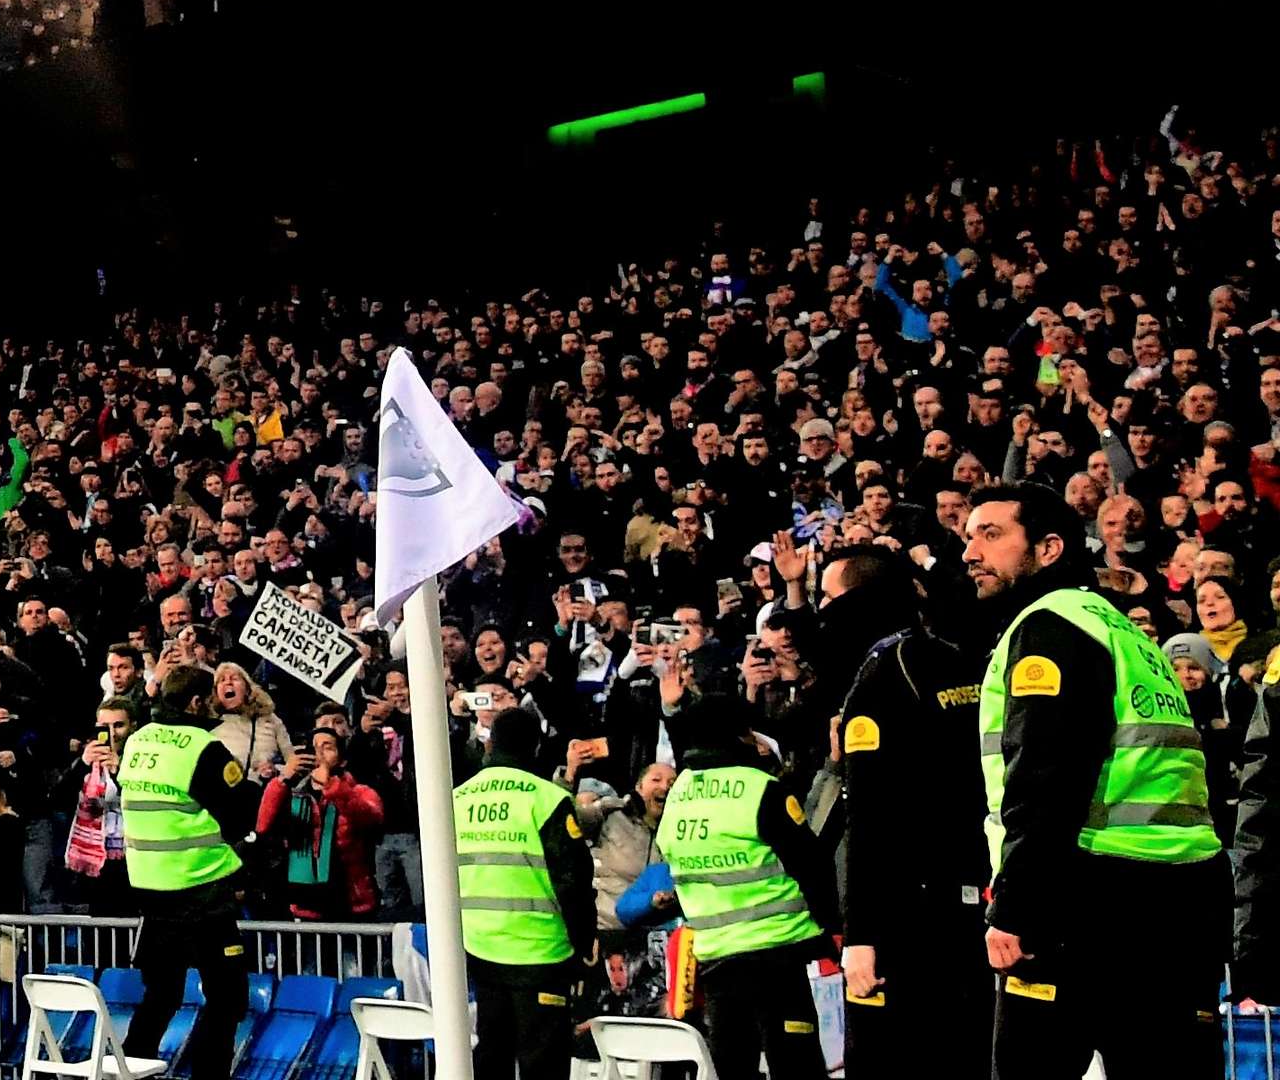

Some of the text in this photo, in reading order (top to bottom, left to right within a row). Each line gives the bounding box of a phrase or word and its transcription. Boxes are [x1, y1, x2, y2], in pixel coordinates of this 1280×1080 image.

[254, 610, 332, 669] CAMISETA
[329, 638, 346, 656] TU
[247, 628, 324, 680] POR FAVOR?
[129, 752, 160, 770] 875
[467, 801, 510, 824] 1068
[460, 830, 528, 844] PROSEGUR
[676, 818, 710, 841] 975
